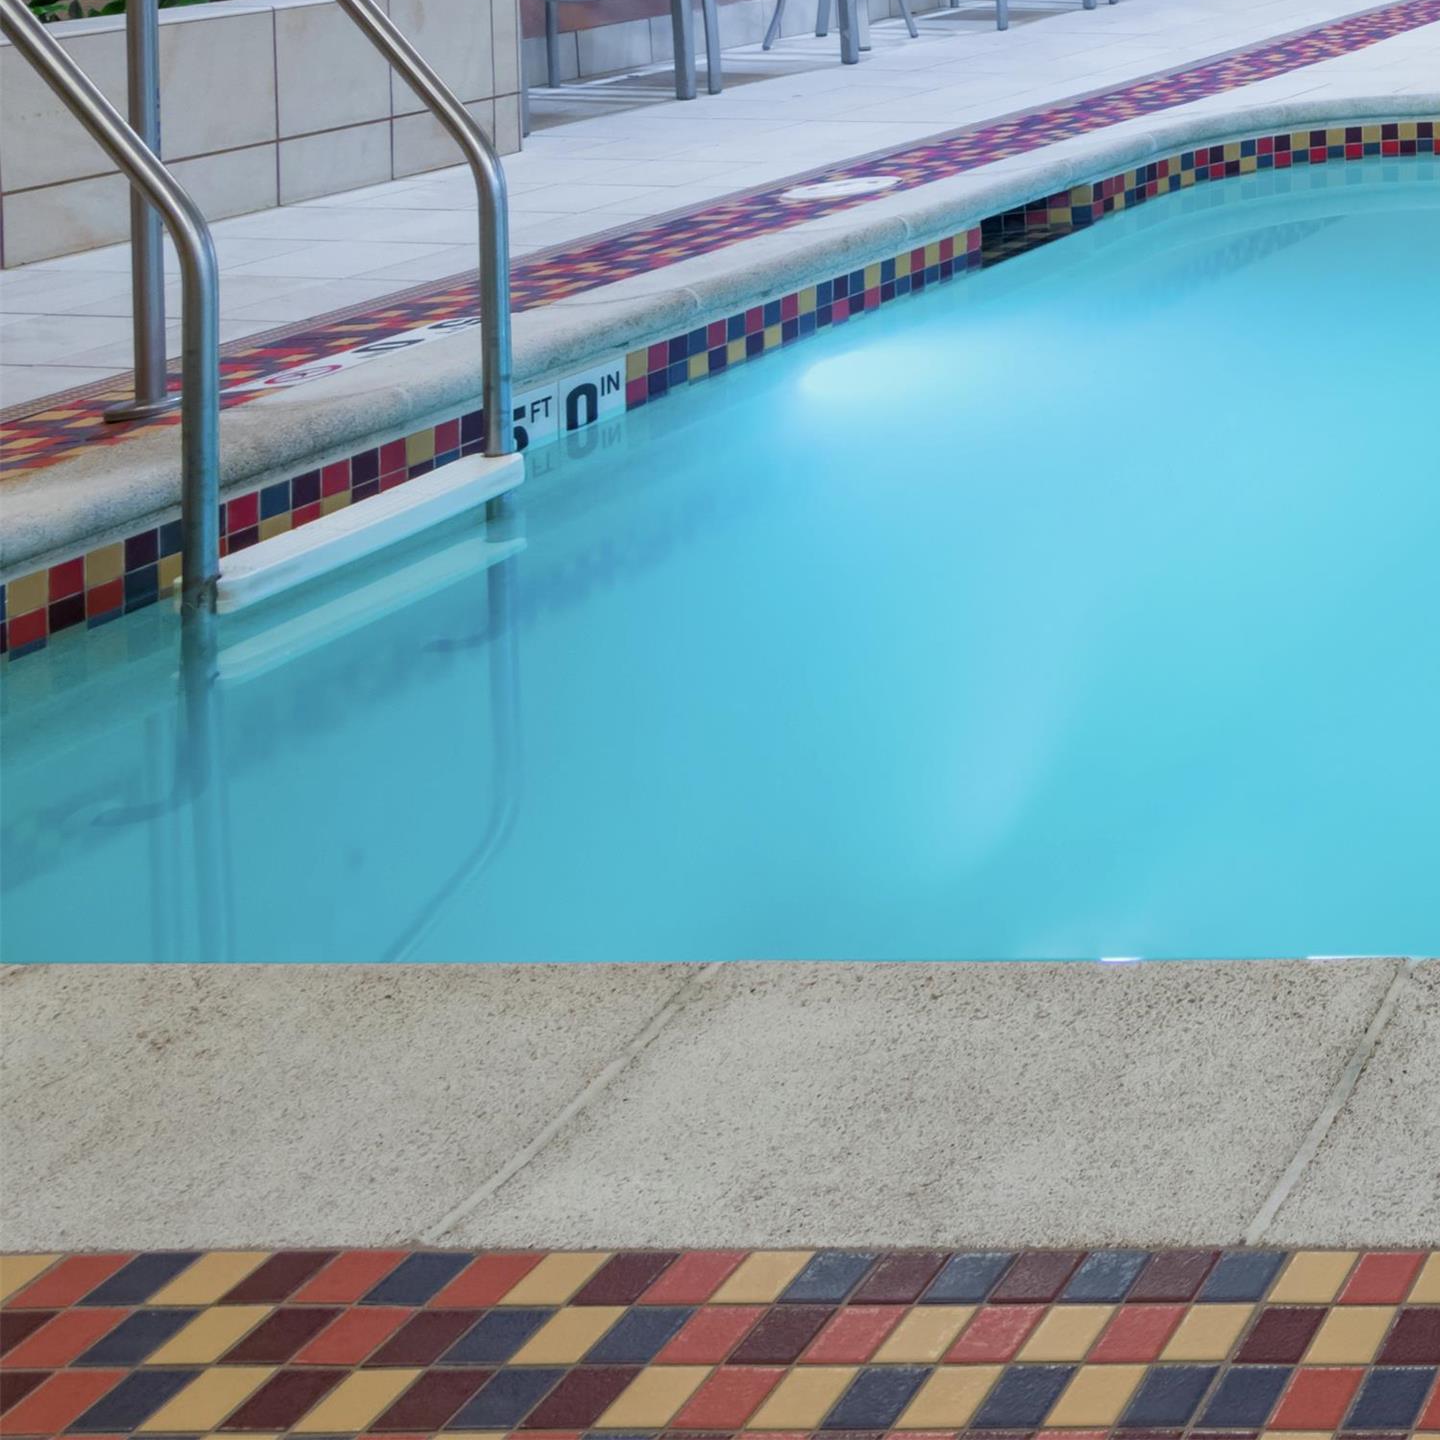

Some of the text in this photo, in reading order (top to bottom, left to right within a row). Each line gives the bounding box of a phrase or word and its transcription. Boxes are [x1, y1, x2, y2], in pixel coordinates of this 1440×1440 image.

[530, 371, 620, 431] FT 0 IN
